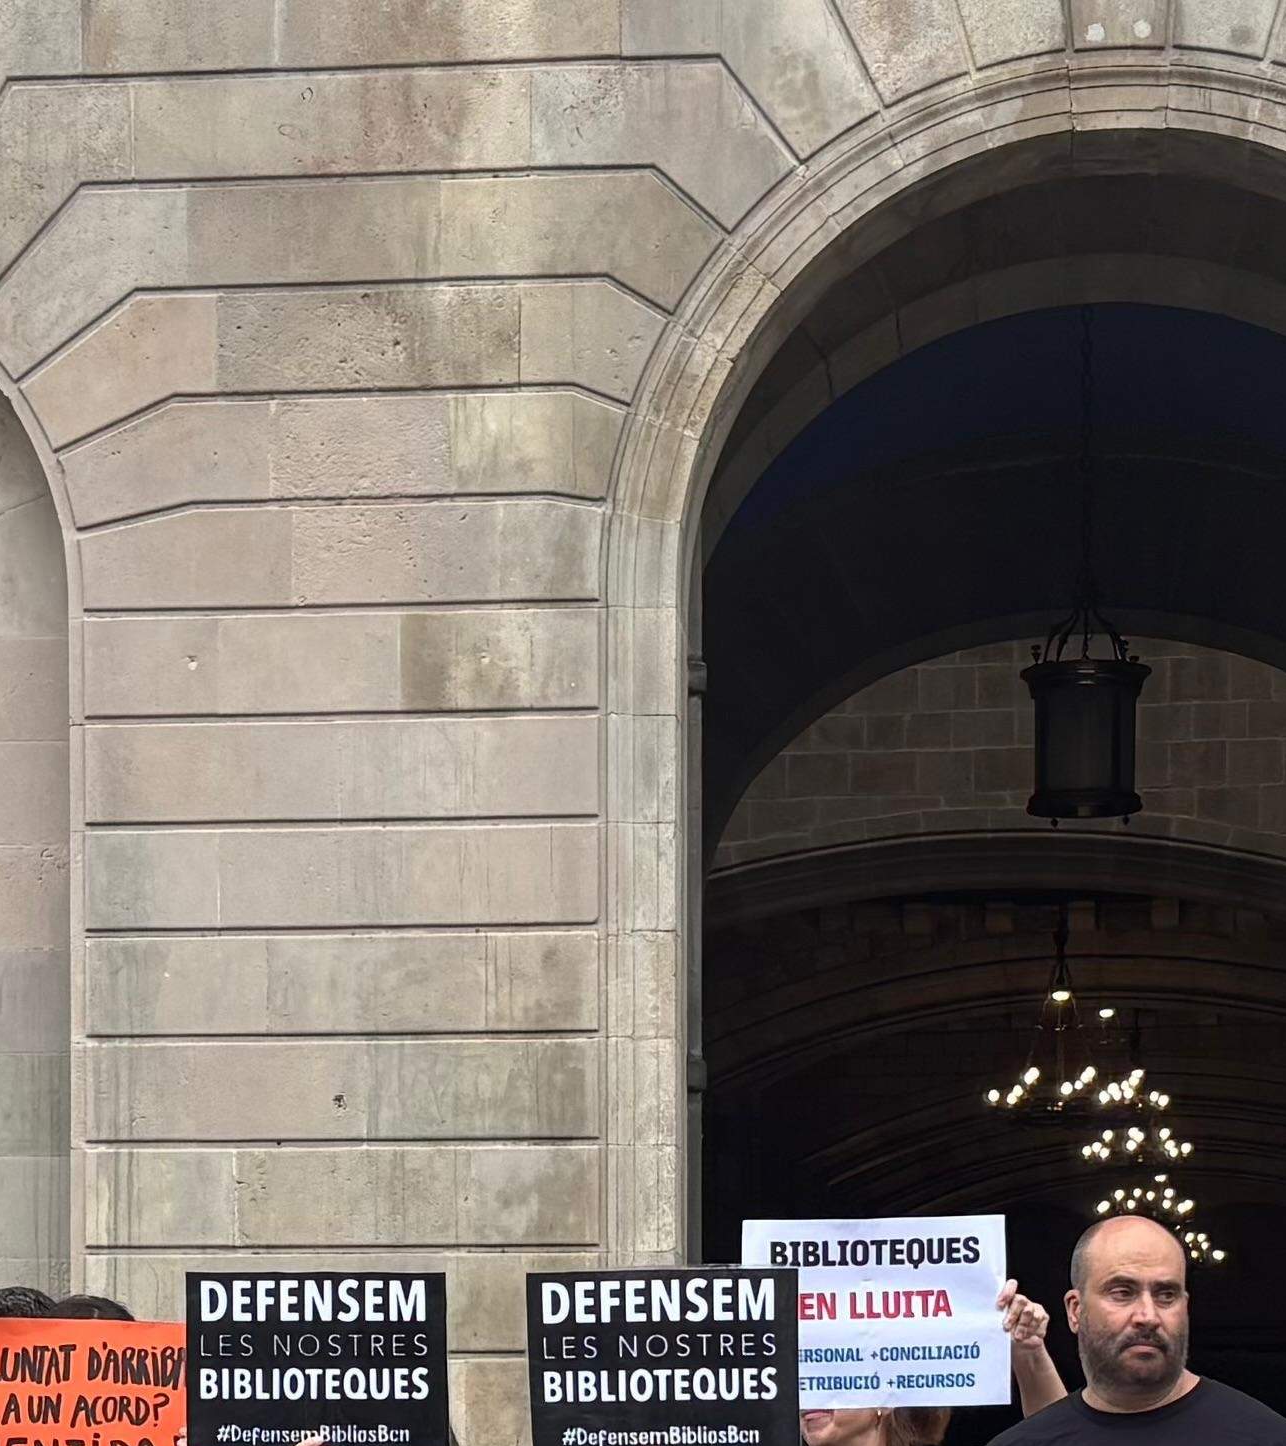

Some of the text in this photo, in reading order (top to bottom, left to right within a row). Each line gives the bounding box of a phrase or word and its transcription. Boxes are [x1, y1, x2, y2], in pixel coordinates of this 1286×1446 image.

[770, 1236, 980, 1270] BIBLIOTEQUES
[199, 1279, 426, 1322] DEFENSEM
[541, 1277, 774, 1325] DEFENSEM
[800, 1289, 952, 1320] EN LLUITA
[200, 1334, 428, 1357] LES NOSTRES
[543, 1332, 776, 1360] LES NOSTRES
[870, 1341, 980, 1361] +CONCILIACIÓ
[199, 1367, 430, 1400] BIBLIOTEQUES
[543, 1366, 778, 1403] BIBLIOTEQUES
[887, 1373, 975, 1389] +RECURSOS
[1, 1393, 170, 1428] A UN ACORD?
[562, 1426, 760, 1446] #DefensemBibliosBcn
